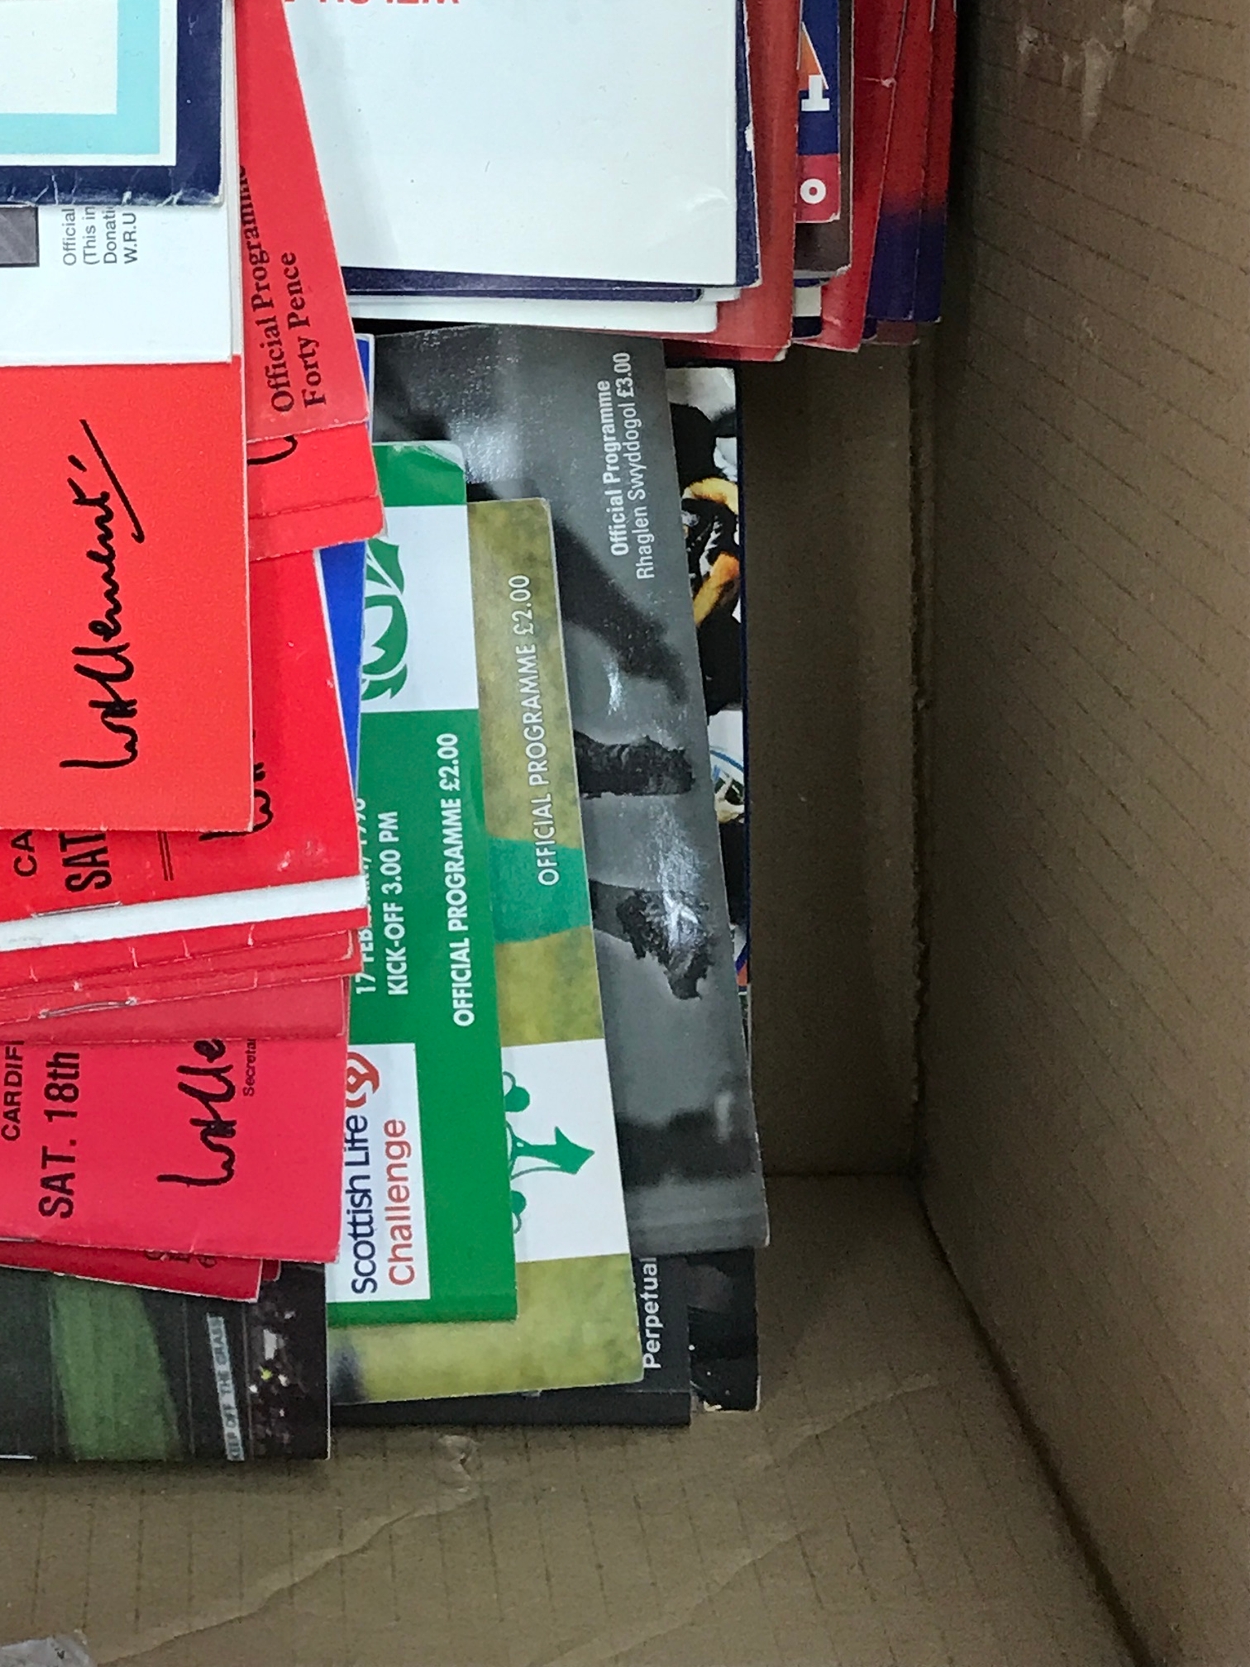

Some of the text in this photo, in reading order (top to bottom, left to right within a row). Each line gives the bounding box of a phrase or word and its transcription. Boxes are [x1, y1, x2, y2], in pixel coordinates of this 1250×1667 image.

[62, 209, 76, 266] Official
[83, 225, 100, 266] (This
[100, 207, 117, 265] Donati
[257, 314, 294, 413] Official
[285, 250, 328, 409] Forty Pence
[599, 379, 629, 556] Official Programme
[614, 351, 655, 579] Rhaglen Swyddogol £3.00
[509, 574, 560, 886] OFFICIAL PROGRAMME £2.00
[378, 812, 408, 995] KICK-OFF 3.00 PM
[437, 733, 476, 1027] OFFICIAL PROGRAMME £2.00
[356, 973, 376, 995] 17
[39, 1052, 81, 1219] SAT. 18th
[344, 1115, 377, 1294] Scottish Life
[384, 1119, 415, 1285] Challenge
